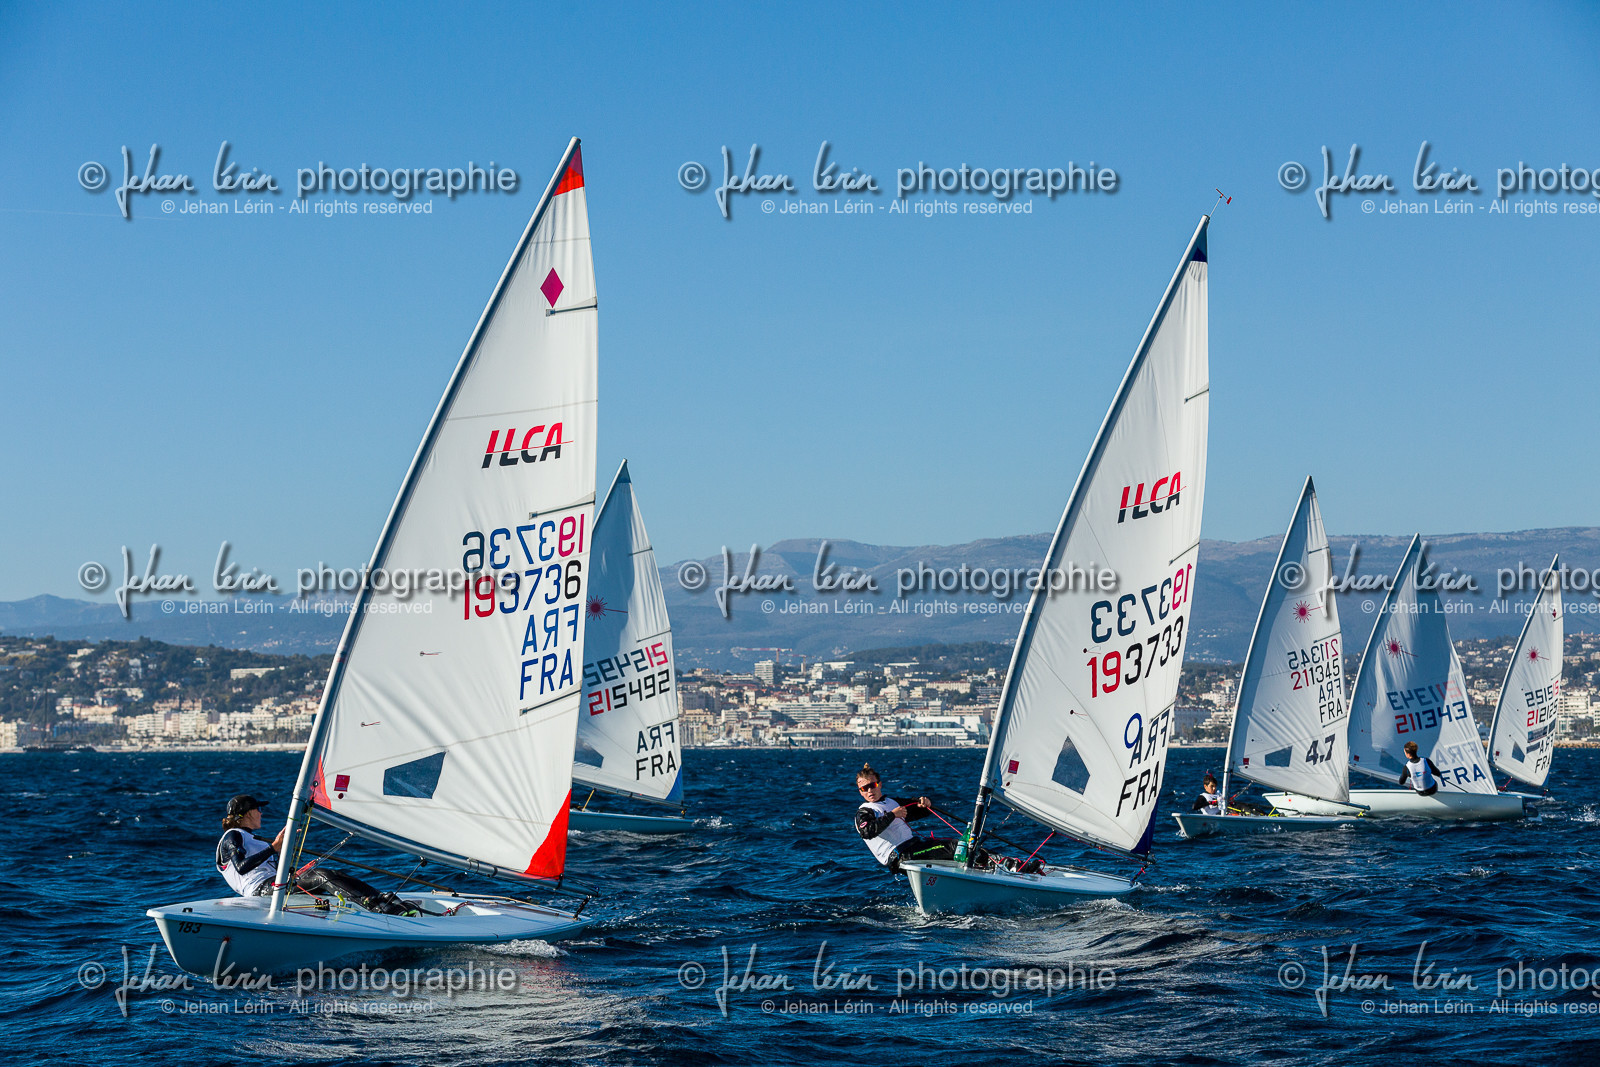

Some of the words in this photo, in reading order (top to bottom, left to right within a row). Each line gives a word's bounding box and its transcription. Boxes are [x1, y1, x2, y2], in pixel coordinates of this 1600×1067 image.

[481, 422, 562, 469] ILCA
[1118, 471, 1181, 524] ILCA
[464, 560, 581, 620] 193736
[519, 648, 574, 700] FRA
[1087, 615, 1184, 698] 193733
[1290, 658, 1340, 690] 211345
[588, 668, 670, 716] 215492
[1319, 698, 1343, 723] FRA
[1395, 701, 1467, 734] 211343
[636, 750, 676, 780] FRA
[1305, 733, 1335, 765] 4.7
[1116, 761, 1159, 817] FRA
[1440, 763, 1486, 787] FRA
[178, 921, 202, 934] 183
